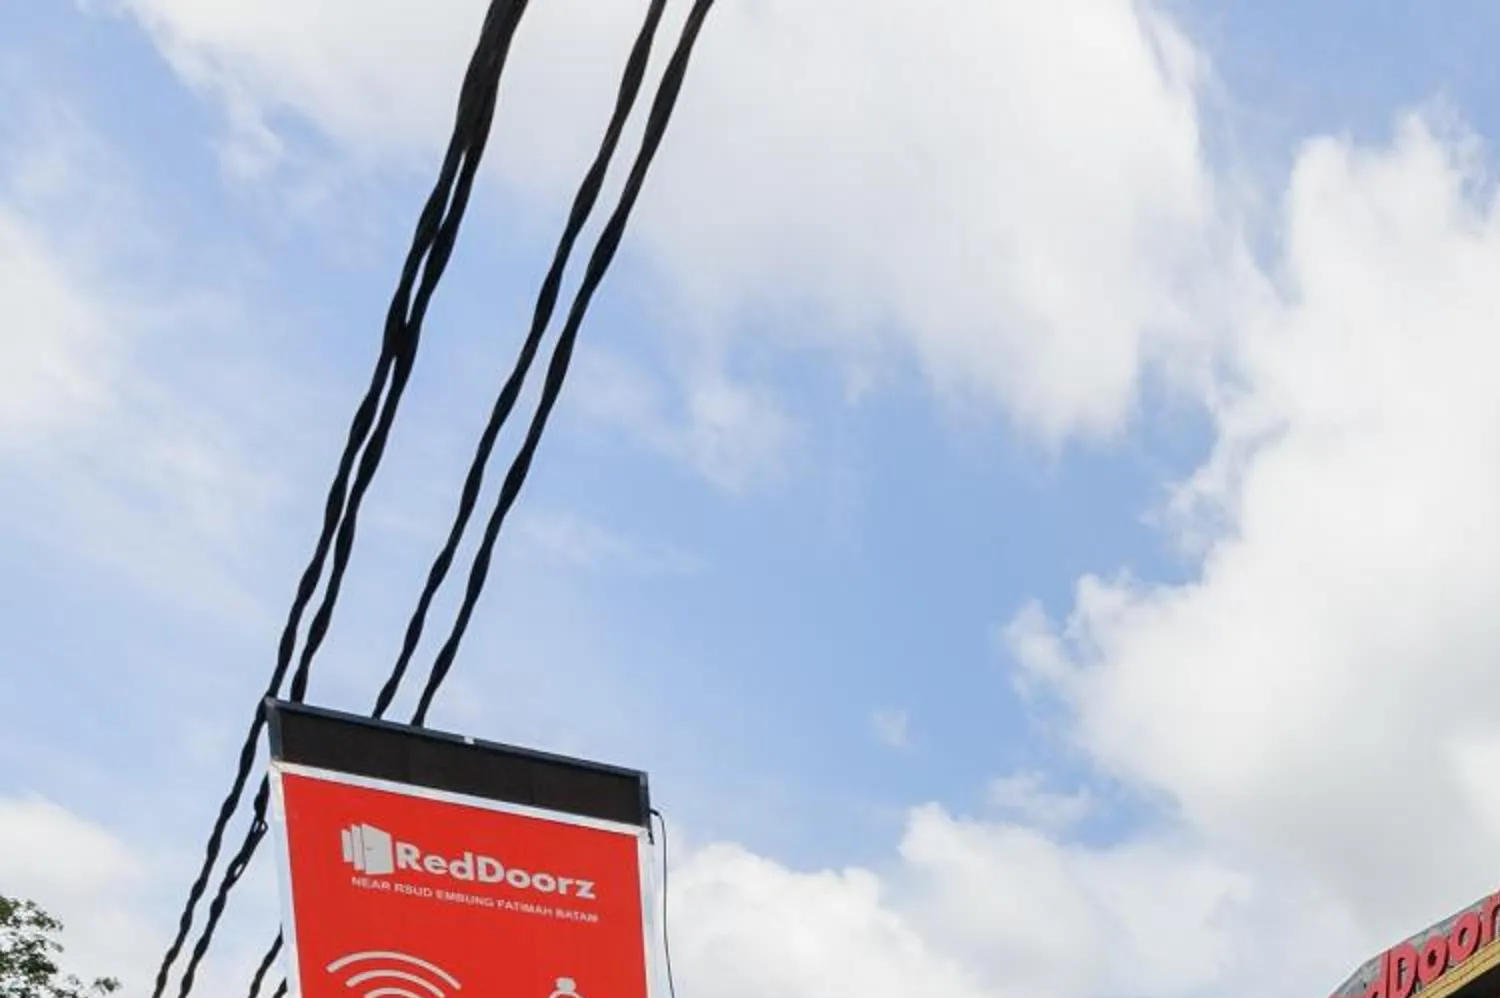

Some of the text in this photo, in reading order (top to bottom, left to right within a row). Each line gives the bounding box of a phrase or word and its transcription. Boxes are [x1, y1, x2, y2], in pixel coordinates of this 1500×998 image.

[395, 840, 597, 900] RedDoorz
[351, 875, 599, 924] NEAR RSUD EMBUNG FATIMAH BATAM
